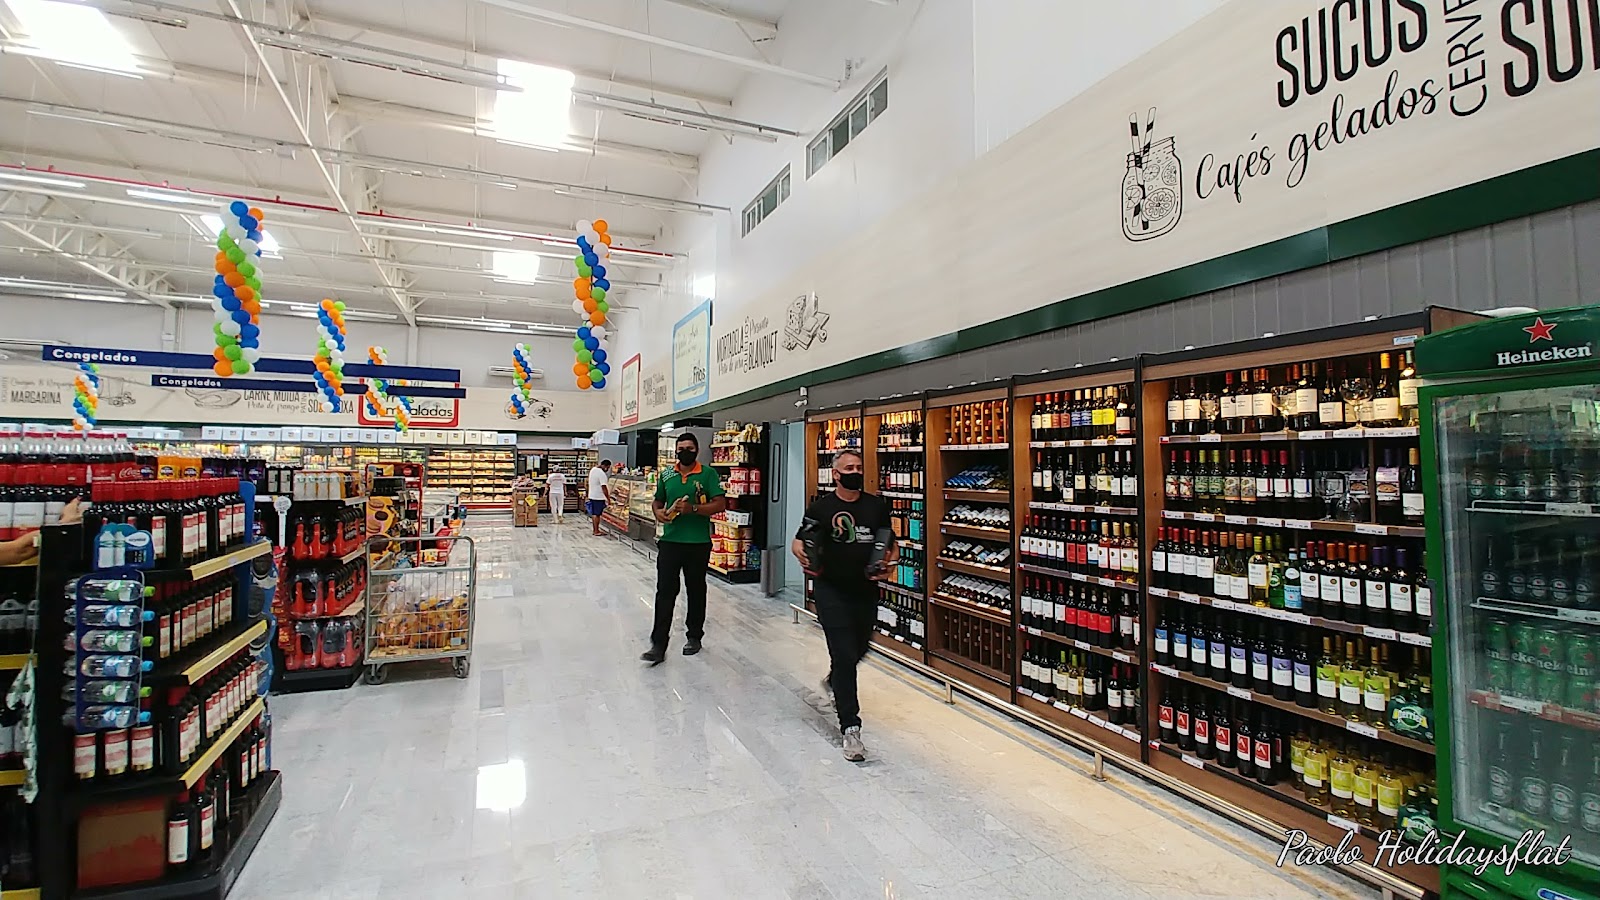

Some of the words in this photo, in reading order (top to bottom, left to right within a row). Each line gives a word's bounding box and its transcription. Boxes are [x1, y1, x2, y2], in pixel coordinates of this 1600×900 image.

[1276, 0, 1428, 108] SUCOS
[1196, 132, 1276, 204] Cafés
[1286, 69, 1444, 189] gelados
[52, 348, 137, 363] Congelados
[1496, 345, 1592, 366] Heineken
[159, 376, 222, 387] Congelados
[11, 390, 62, 404] MARGARINA
